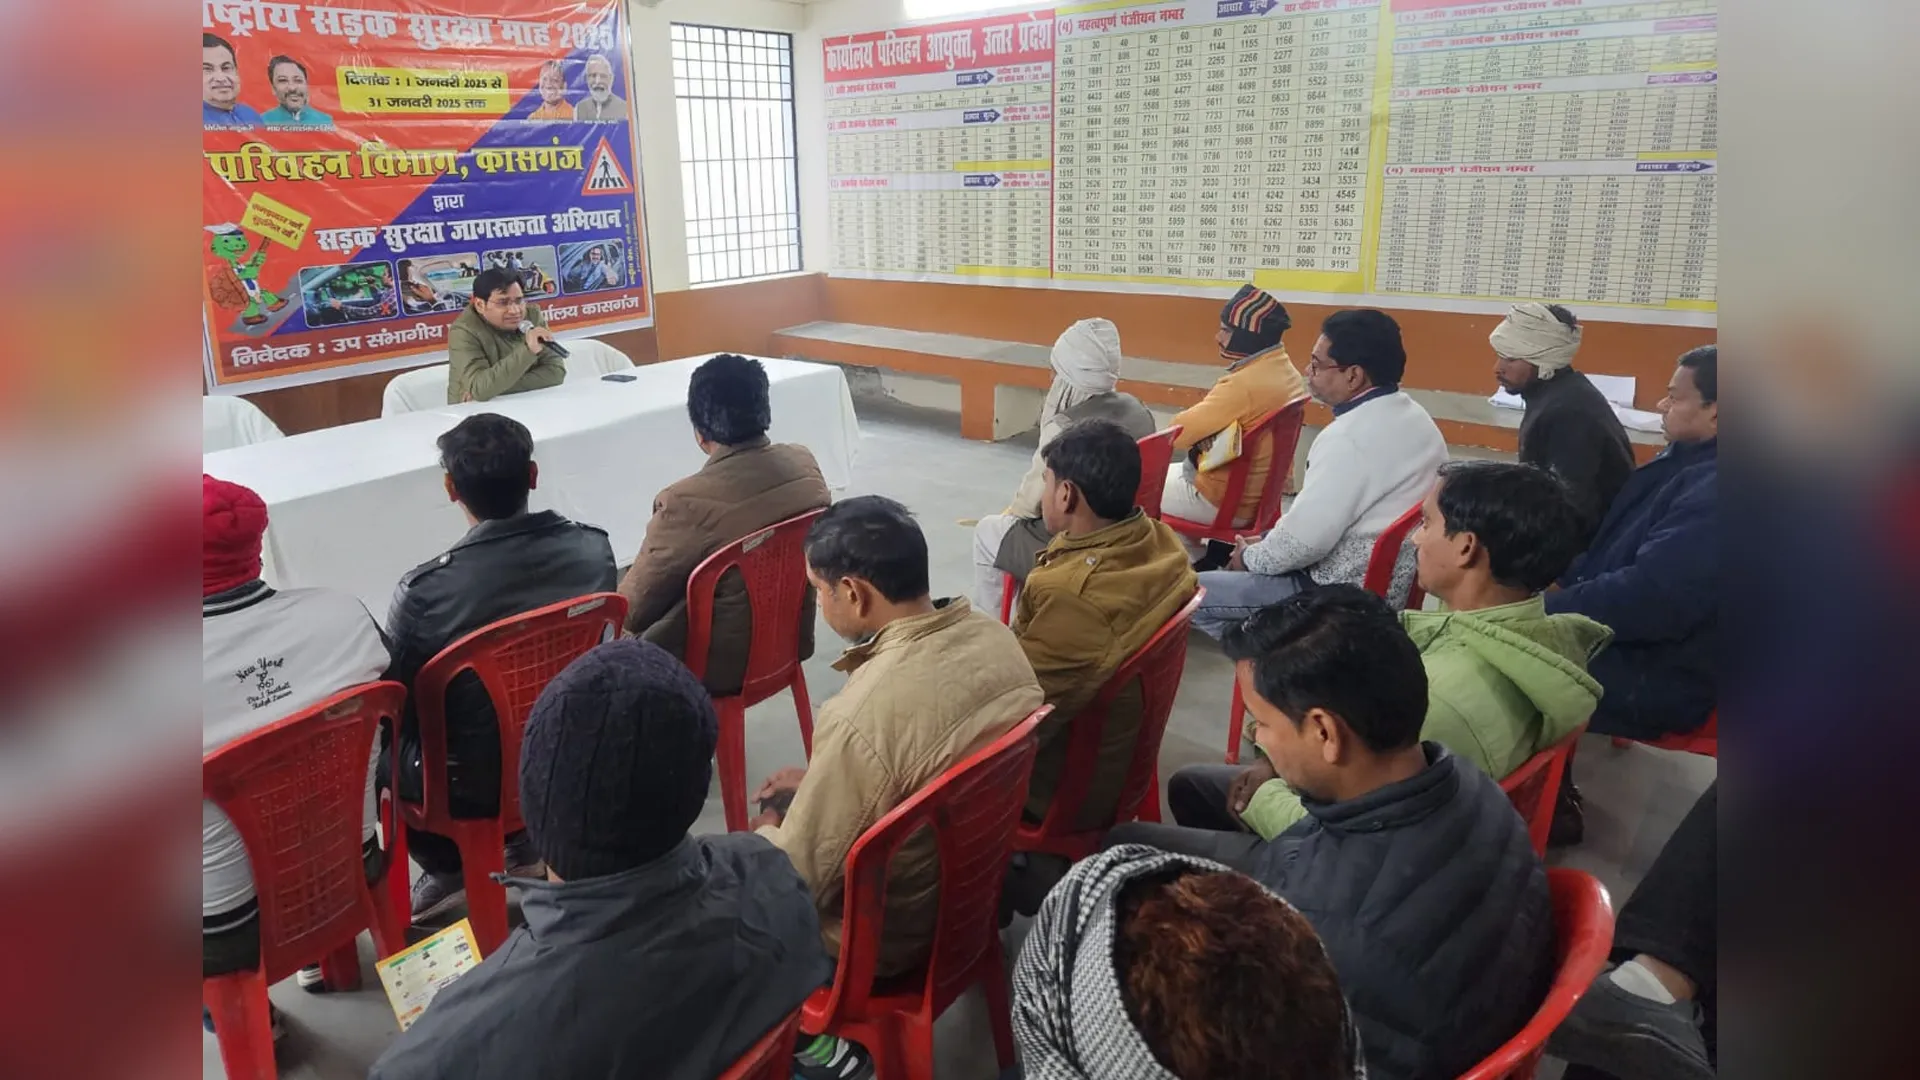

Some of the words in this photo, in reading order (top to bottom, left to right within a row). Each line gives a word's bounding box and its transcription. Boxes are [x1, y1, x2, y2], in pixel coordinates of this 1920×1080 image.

[1078, 12, 1117, 32] महत्वपूर्ण
[1121, 10, 1156, 26] पंजीयन
[1159, 8, 1185, 22] नम्बर
[1243, 23, 1258, 35] 202
[1277, 20, 1292, 32] 303
[1313, 16, 1329, 28] 404
[306, 5, 397, 44] सड़क
[402, 12, 492, 50] सुरक्षा
[498, 20, 549, 46] माह
[557, 22, 614, 50] 2025
[826, 35, 875, 72] कार्यालय
[877, 31, 923, 67] परिवहन
[926, 28, 977, 70] आयुक्त,
[982, 24, 1014, 56] उत्तर
[1018, 12, 1054, 54] प्रदेश
[1209, 40, 1226, 52] 1144
[1241, 37, 1259, 49] 1155
[1273, 49, 1293, 61] 2277
[1238, 65, 1258, 77] 3377
[415, 75, 459, 88] जनवरी
[464, 79, 487, 88] 2025
[491, 76, 502, 88] से
[1271, 78, 1290, 90] 5511
[1308, 75, 1328, 87] 5522
[1466, 83, 1508, 94] पंजीयन
[1513, 82, 1543, 91] नम्बर
[368, 97, 381, 108] 31
[387, 95, 433, 108] जनवरी
[437, 99, 461, 108] 2025
[464, 99, 487, 108] तक
[1237, 108, 1255, 120] 7744
[1271, 105, 1290, 117] 7755
[1270, 134, 1288, 146] 1786
[203, 142, 352, 182] परिवहन
[357, 141, 468, 179] विभाग,
[471, 137, 584, 173] कासगंज
[1268, 148, 1287, 160] 1212
[1304, 146, 1323, 159] 1313
[1340, 145, 1360, 157] 1414
[1233, 162, 1251, 174] 2121
[1301, 161, 1322, 173] 2323
[1338, 160, 1359, 172] 2424
[1460, 165, 1500, 173] पंजीयन
[1505, 165, 1535, 173] नम्बर
[1303, 174, 1321, 186] 3434
[1337, 174, 1358, 186] 3535
[1169, 189, 1187, 202] 4040
[1201, 189, 1218, 201] 4041
[1232, 189, 1250, 201] 4141
[1266, 189, 1284, 201] 4242
[1300, 188, 1320, 200] 4343
[1336, 188, 1356, 200] 4545
[432, 194, 465, 212] द्वारा
[1231, 202, 1249, 215] 5151
[1265, 202, 1284, 214] 5252
[1300, 202, 1319, 214] 5353
[1335, 202, 1355, 214] 5445
[1263, 216, 1283, 228] 6262
[1334, 216, 1354, 229] 6363
[314, 227, 377, 254] सड़क
[380, 221, 446, 253] सुरक्षा
[551, 207, 622, 233] अभियान
[1263, 229, 1281, 242] 7171
[1298, 230, 1317, 242] 7227
[1334, 230, 1352, 242] 7272
[1263, 242, 1281, 255] 7979
[1330, 258, 1349, 270] 9191
[581, 294, 639, 314] कासगंज
[231, 343, 312, 367] निवेदक
[331, 336, 361, 352] उप
[366, 323, 443, 348] संभागीय
[235, 665, 256, 683] New
[257, 657, 284, 670] York
